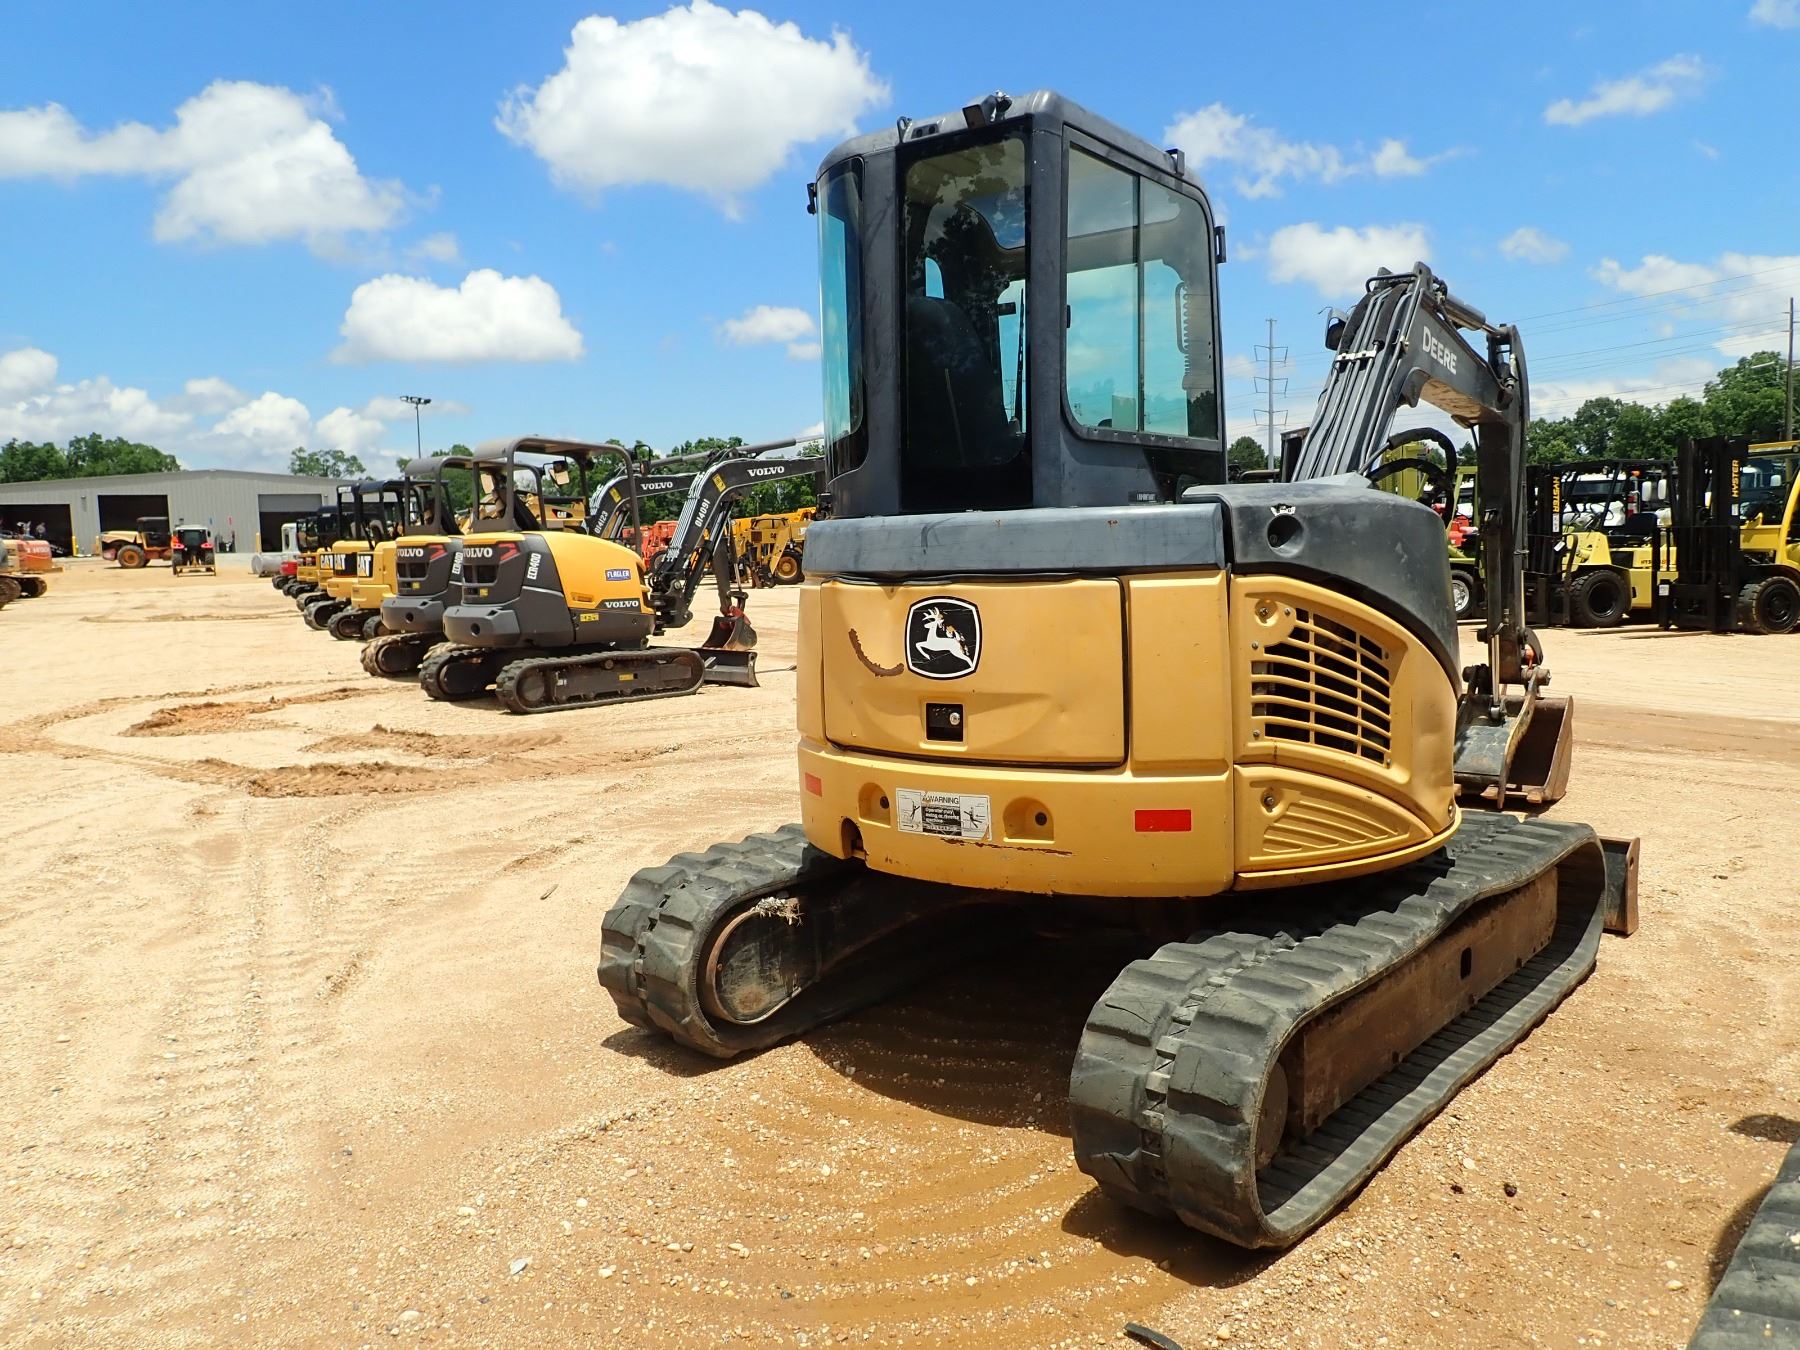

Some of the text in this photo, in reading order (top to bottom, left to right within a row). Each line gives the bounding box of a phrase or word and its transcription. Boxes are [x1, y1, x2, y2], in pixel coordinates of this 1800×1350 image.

[1422, 325, 1457, 375] DEERE
[747, 466, 785, 477] VOLVO
[1731, 459, 1740, 498] HYSTER
[640, 481, 674, 491] VOLVO
[1552, 476, 1561, 513] HYSTER
[557, 511, 567, 519] CAT
[694, 499, 711, 528] 014091
[593, 510, 609, 534] 014123
[397, 548, 424, 558] VOLVO
[463, 547, 493, 558] VOLVO
[607, 569, 630, 578] FLAGLER
[605, 600, 639, 608] VOLVO
[928, 796, 959, 805] WARNING
